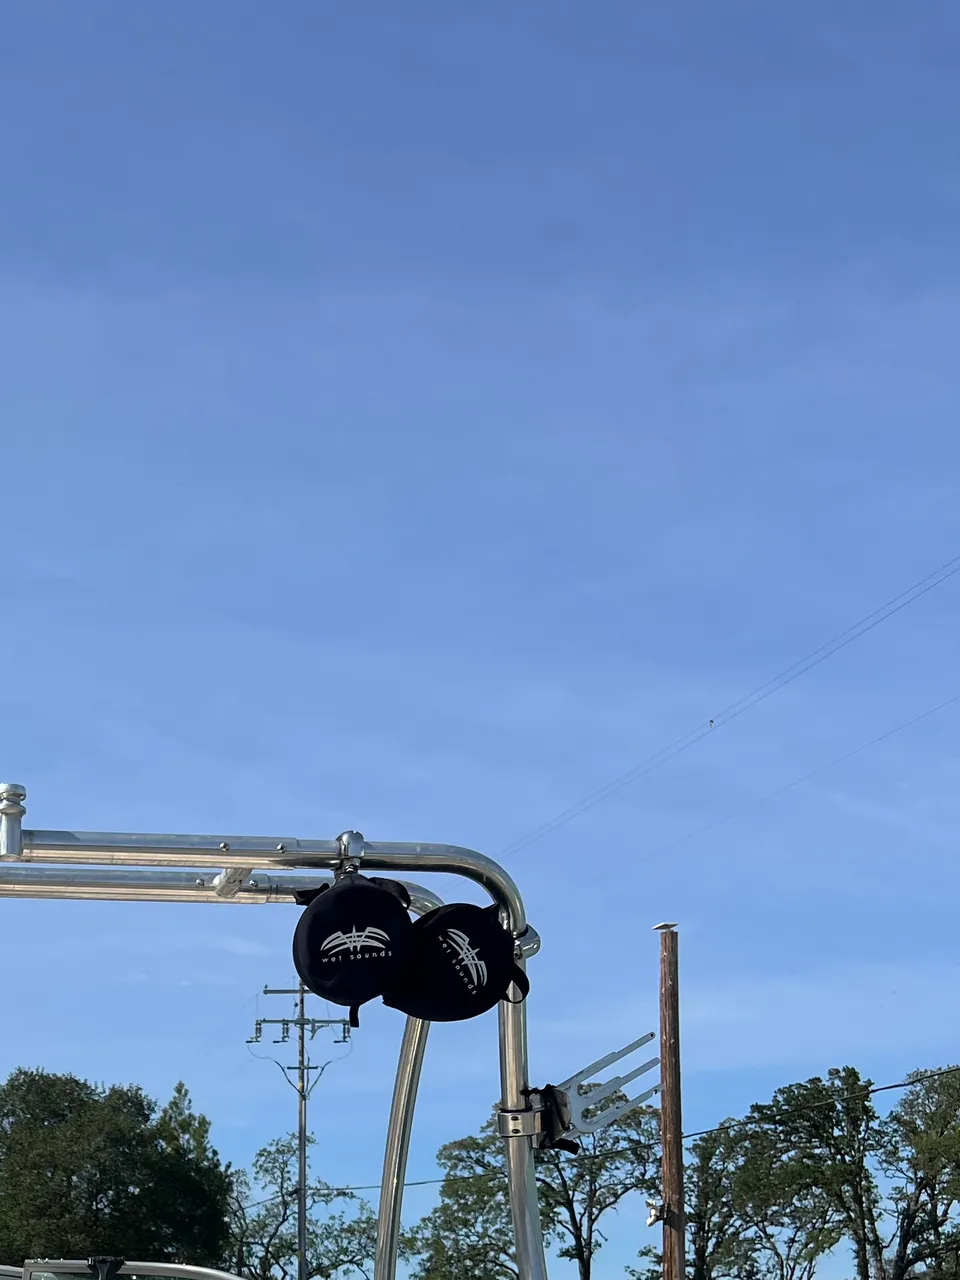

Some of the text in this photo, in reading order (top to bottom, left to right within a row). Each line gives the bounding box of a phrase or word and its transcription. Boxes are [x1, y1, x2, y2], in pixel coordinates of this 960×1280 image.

[321, 950, 392, 963] wet sounds
[438, 935, 477, 995] wet sounds
